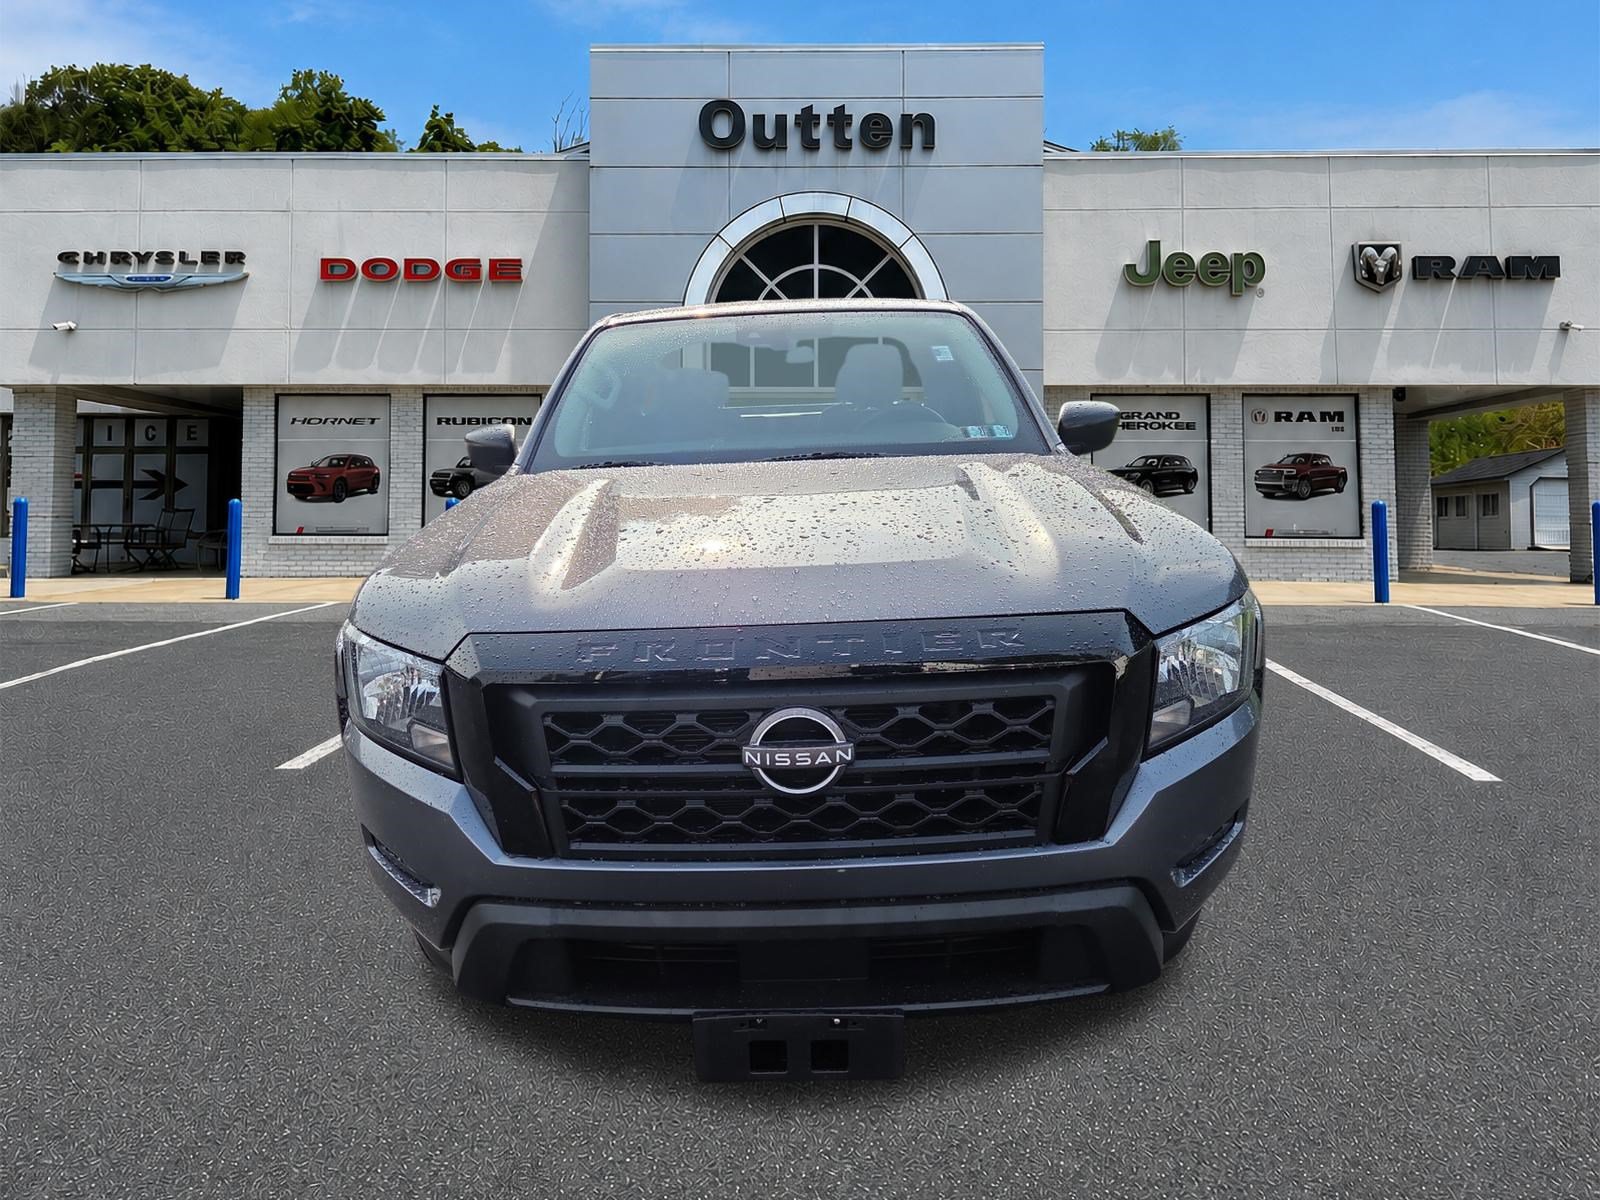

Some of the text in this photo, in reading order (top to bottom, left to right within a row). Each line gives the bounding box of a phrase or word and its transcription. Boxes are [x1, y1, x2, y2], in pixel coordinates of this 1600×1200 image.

[698, 99, 936, 150] Outten
[57, 251, 247, 266] CHRYSLER
[320, 257, 523, 283] DODGE
[1123, 240, 1266, 297] Jeep
[1411, 255, 1561, 280] RAM
[290, 417, 381, 426] HORNET
[436, 416, 532, 426] RUBICON
[1119, 411, 1180, 420] GRAND
[1274, 411, 1345, 423] RAM
[1117, 421, 1197, 431] HEROKEE
[575, 628, 1025, 662] FRONTIER
[745, 748, 852, 766] NISSAN
